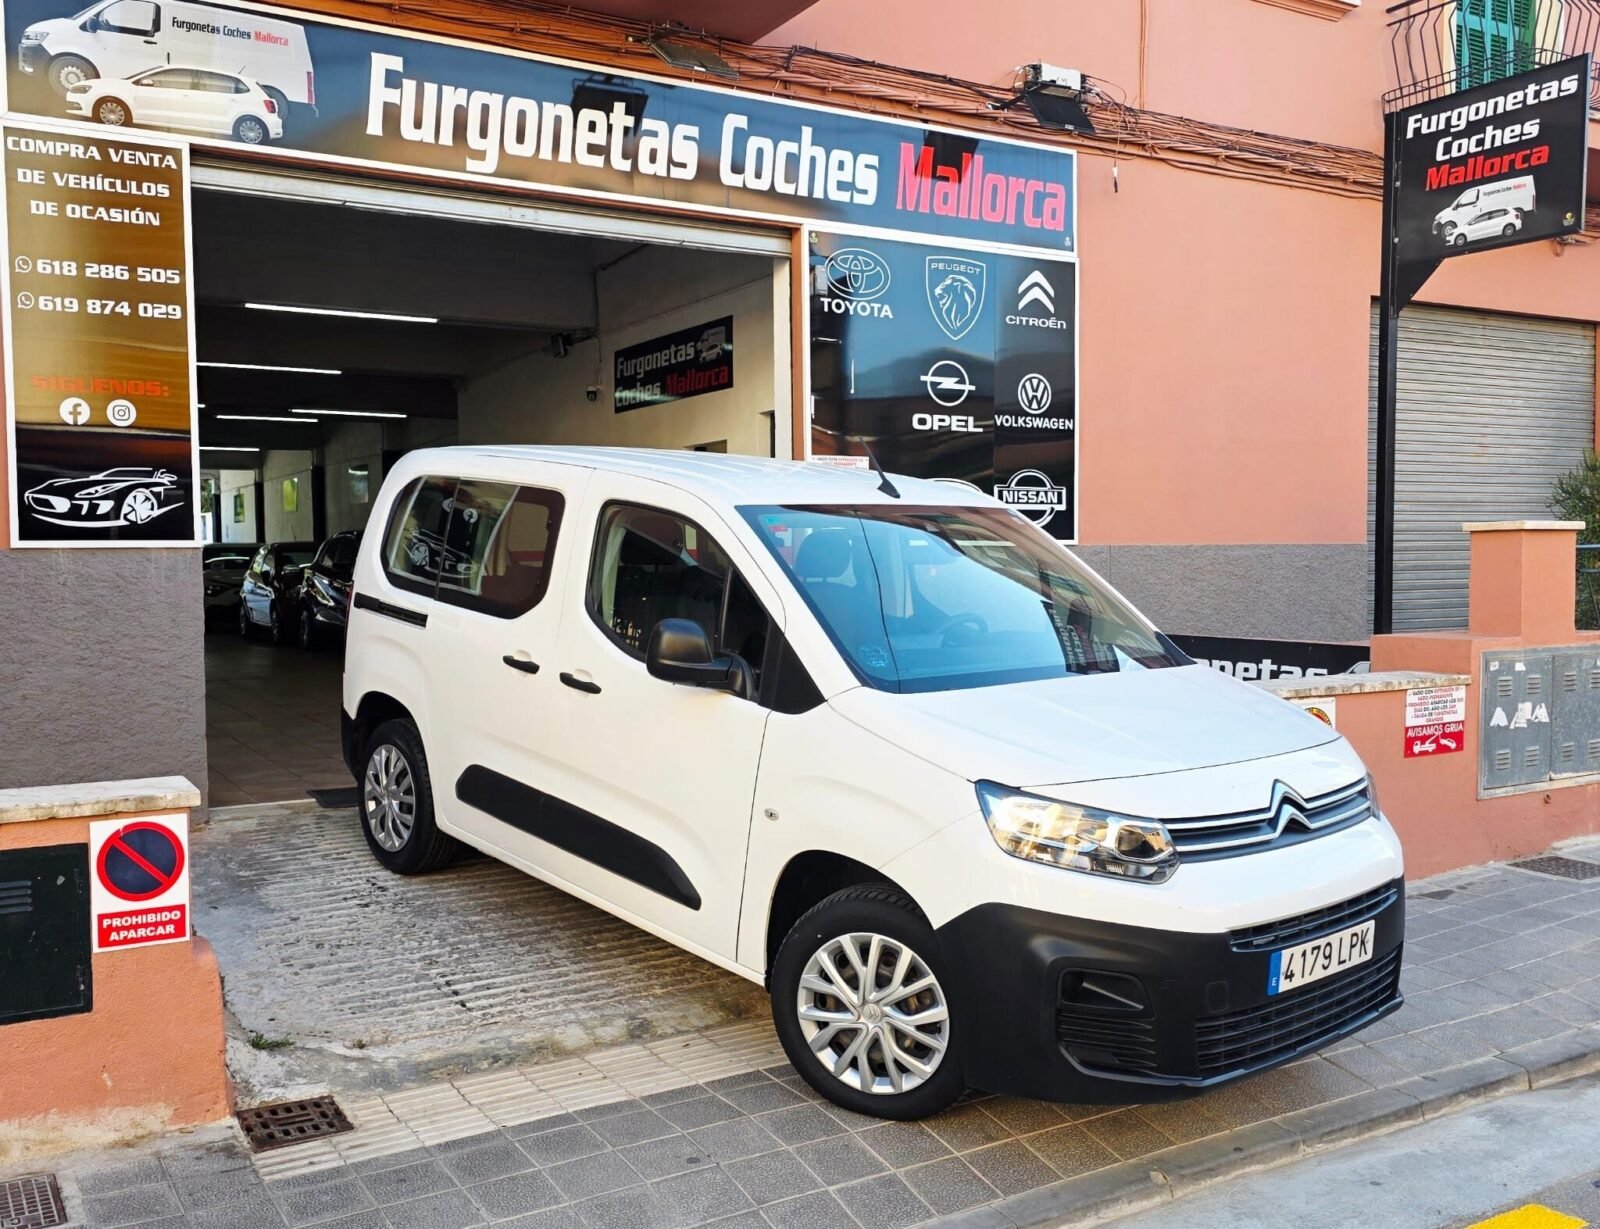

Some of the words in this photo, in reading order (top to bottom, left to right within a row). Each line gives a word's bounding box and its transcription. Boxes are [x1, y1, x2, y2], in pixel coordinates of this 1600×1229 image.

[171, 16, 221, 35] Furgonetas
[222, 24, 252, 41] Coches
[253, 31, 289, 47] Mallorca
[1406, 73, 1580, 140] Furgonetas
[6, 136, 102, 161] COMPRA
[108, 148, 178, 170] VENTA
[365, 51, 699, 181] Furgonetas
[719, 113, 879, 206] Coches
[896, 142, 1066, 232] Mallorca
[1435, 118, 1541, 162] Coches
[1425, 144, 1551, 192] Mallorca
[16, 167, 46, 185] DE
[52, 172, 170, 198] VEHÍCULOS
[30, 200, 59, 216] DE
[65, 204, 161, 226] OCASIÓN
[36, 259, 77, 276] 618
[85, 262, 129, 280] 286
[137, 265, 180, 284] 505
[930, 262, 981, 275] PEUGEOT
[38, 295, 79, 312] 619
[86, 298, 131, 316] 874
[138, 303, 182, 319] 029
[820, 297, 893, 319] TOYOTA
[616, 341, 695, 379] Furgonetas
[664, 365, 729, 396] Mallorca
[615, 382, 661, 408] Coches
[912, 413, 983, 433] OPEL
[995, 414, 1074, 430] VOLKSWAGEN
[1002, 490, 1059, 504] NISSAN
[1407, 724, 1443, 738] AVISAMOS
[1444, 722, 1463, 733] GRUA
[102, 910, 181, 928] PROHIBIDO
[109, 923, 175, 942] APARCAR
[1284, 941, 1333, 982] 4179
[1337, 926, 1370, 966] LPK
